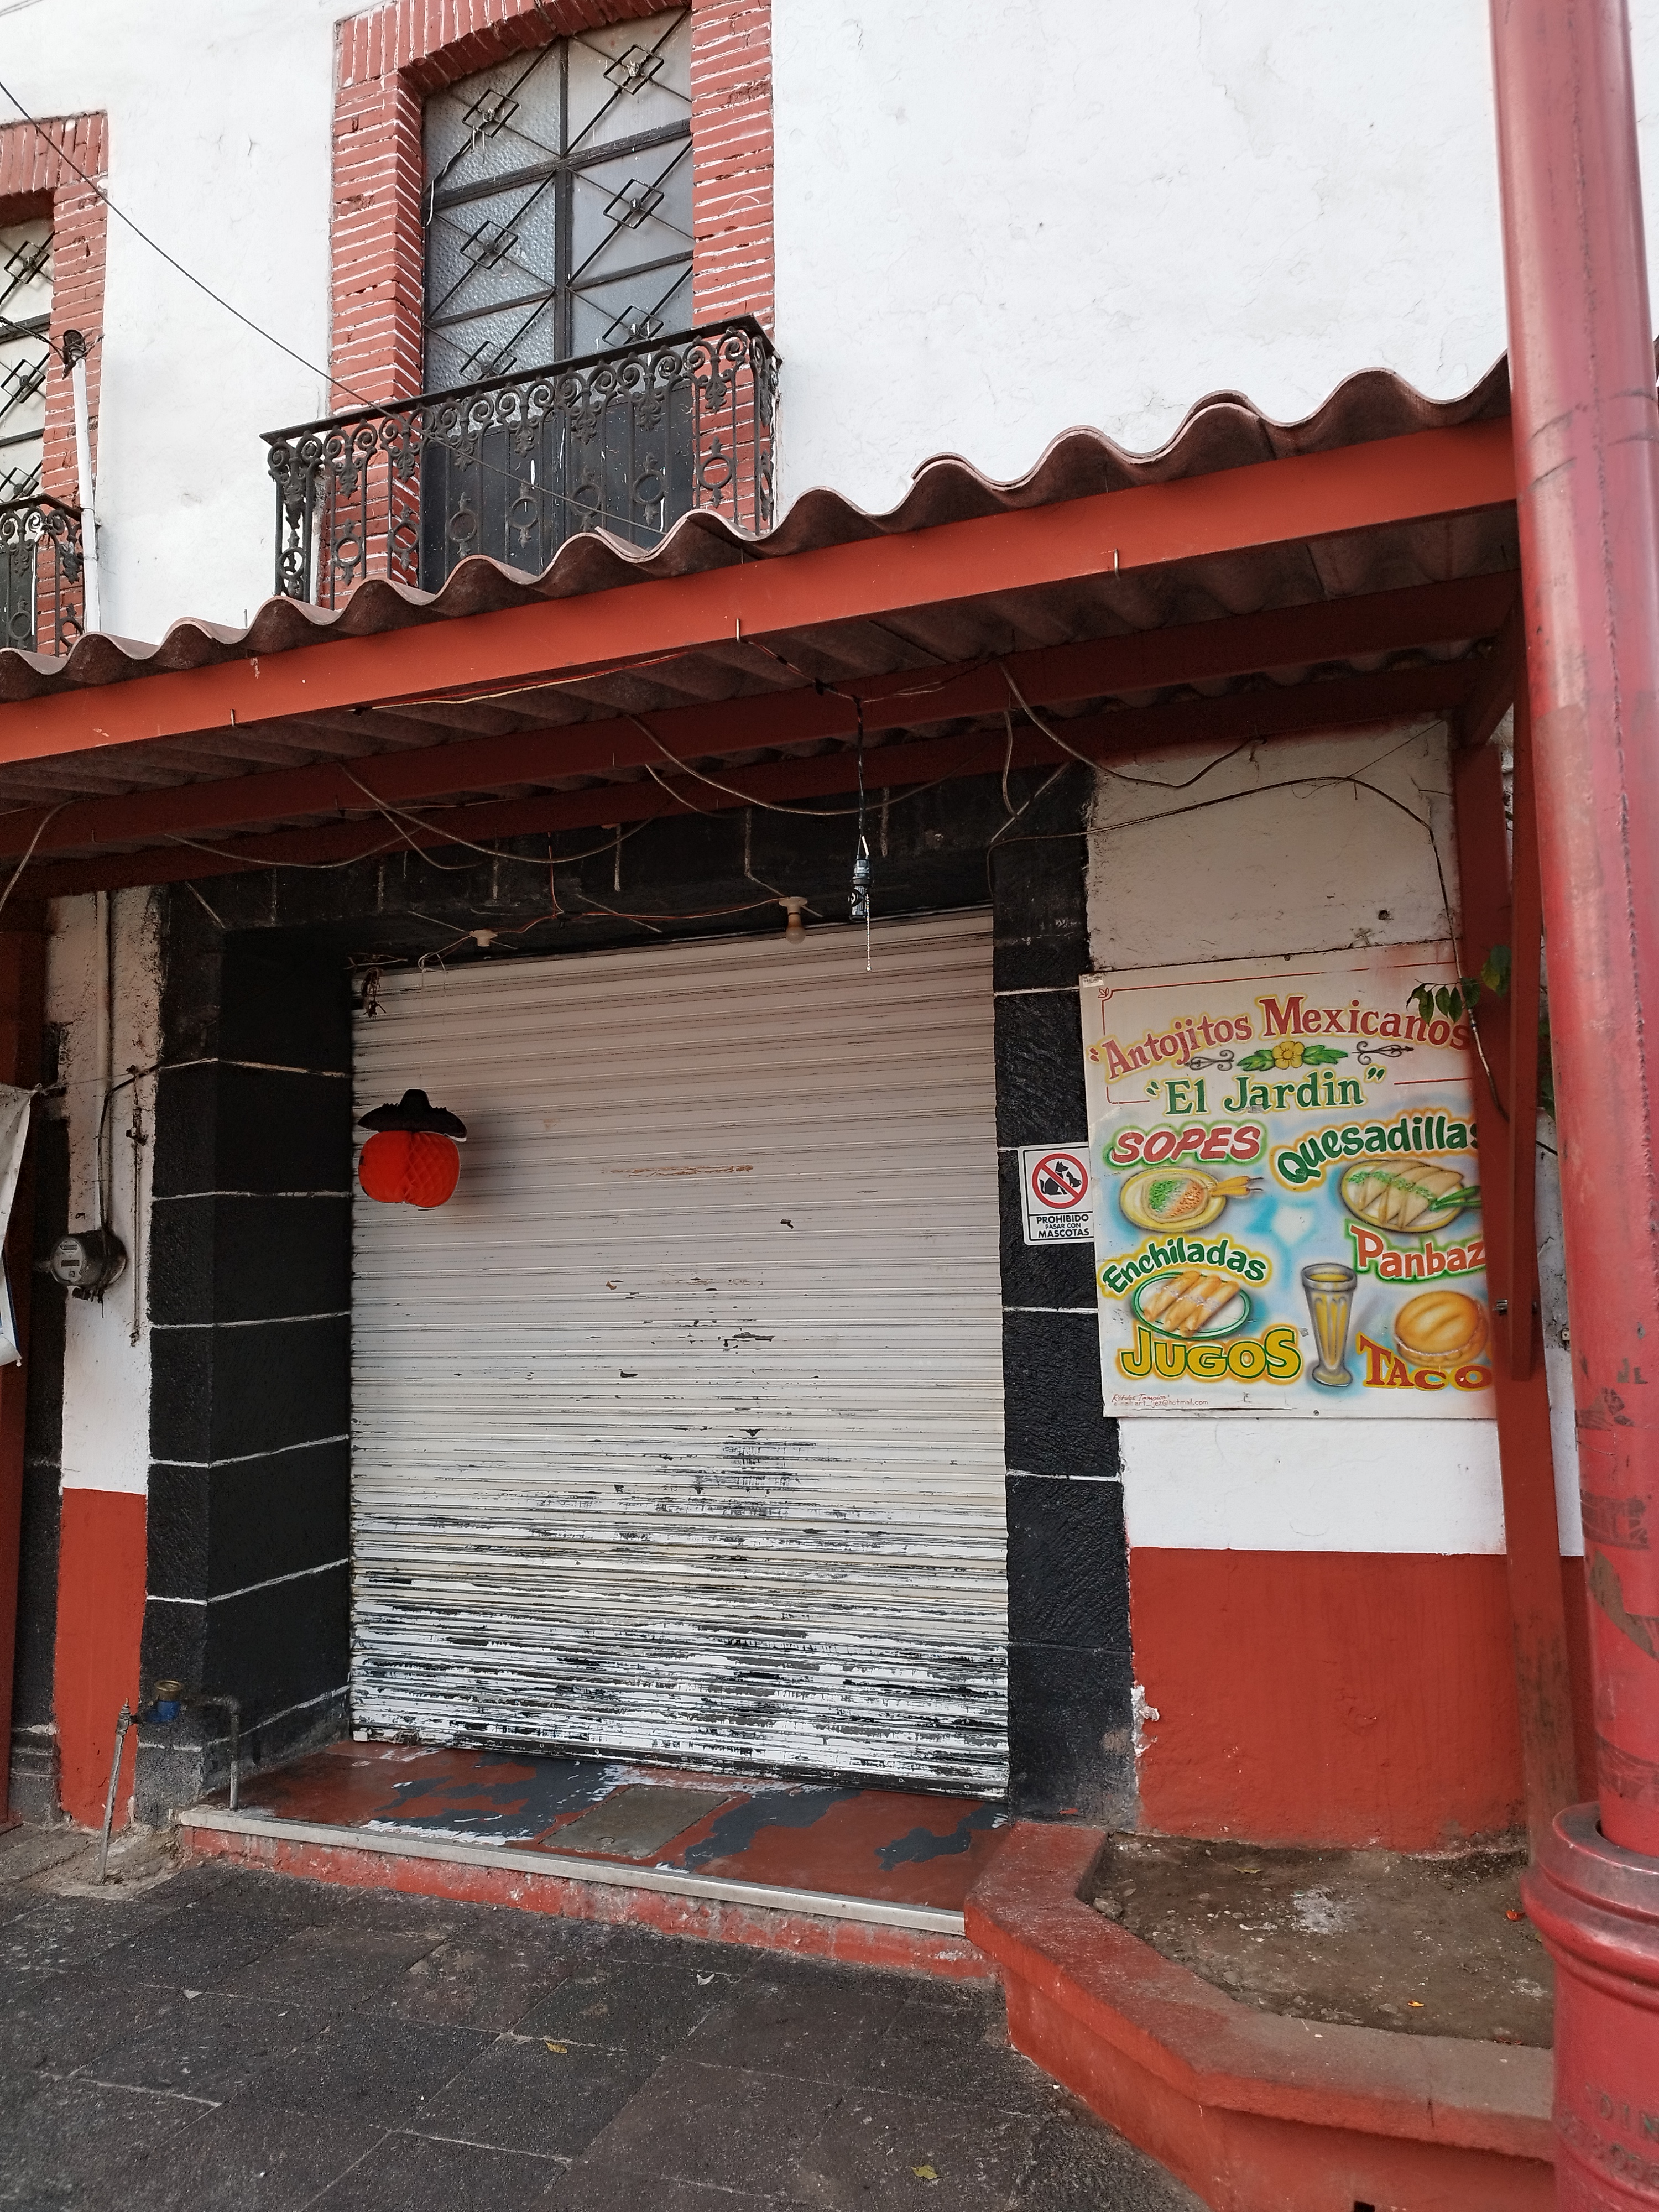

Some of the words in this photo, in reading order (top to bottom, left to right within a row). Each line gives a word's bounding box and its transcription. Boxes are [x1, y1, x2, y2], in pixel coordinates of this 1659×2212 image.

[1259, 996, 1470, 1050] Mexicanos
[1110, 1126, 1261, 1164] SOPES
[1036, 1214, 1089, 1224] PROHIBIDO
[1038, 1228, 1090, 1238] MASCOTAS
[1104, 1237, 1267, 1293] Enchiladas
[1120, 1327, 1302, 1379] JUGOS
[1360, 1339, 1493, 1389] TACO
